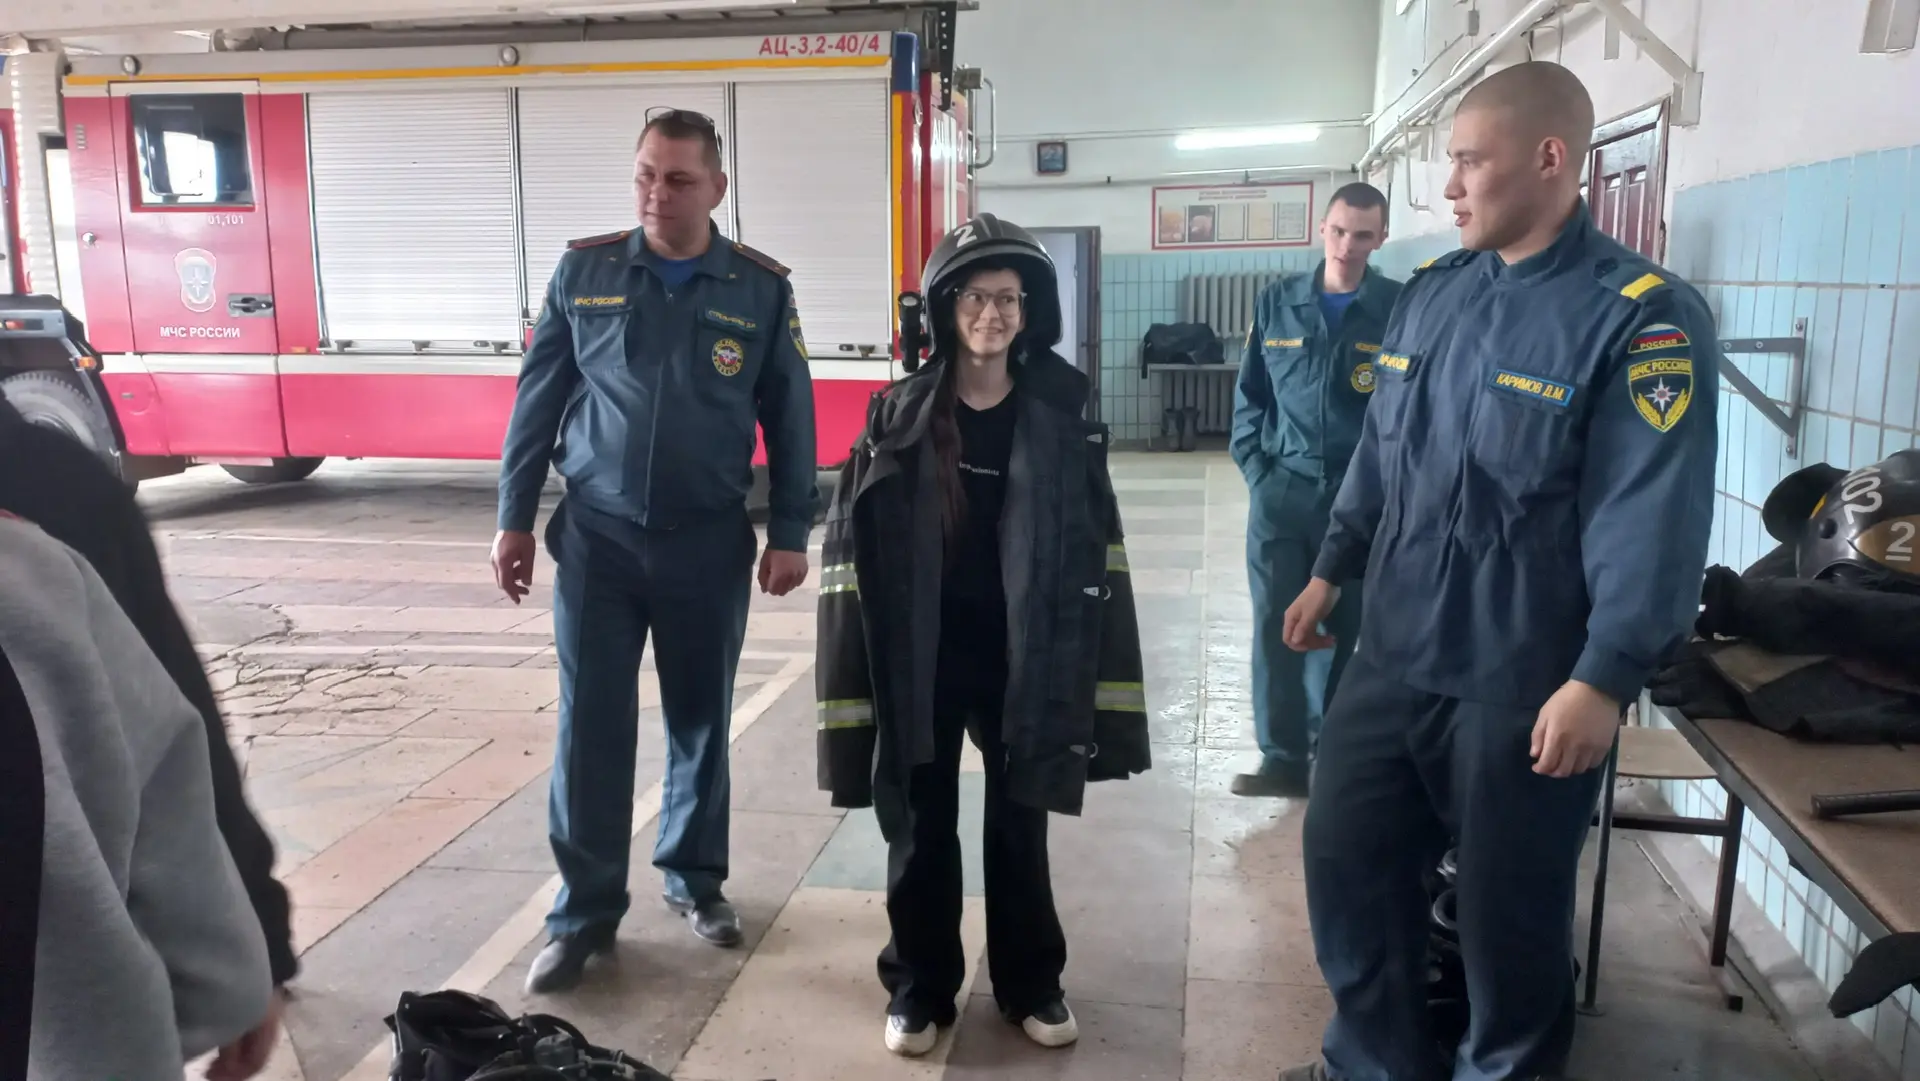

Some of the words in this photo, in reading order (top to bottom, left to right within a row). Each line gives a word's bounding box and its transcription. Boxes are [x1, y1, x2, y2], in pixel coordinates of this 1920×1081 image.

[758, 34, 880, 56] АЦ-3,2-40/4
[953, 224, 978, 248] 2
[159, 326, 187, 338] МЧС
[189, 326, 241, 338] РОССИИ
[1630, 363, 1652, 377] МЧС
[1496, 373, 1543, 394] КАРИМОВ
[1886, 521, 1916, 554] 2
